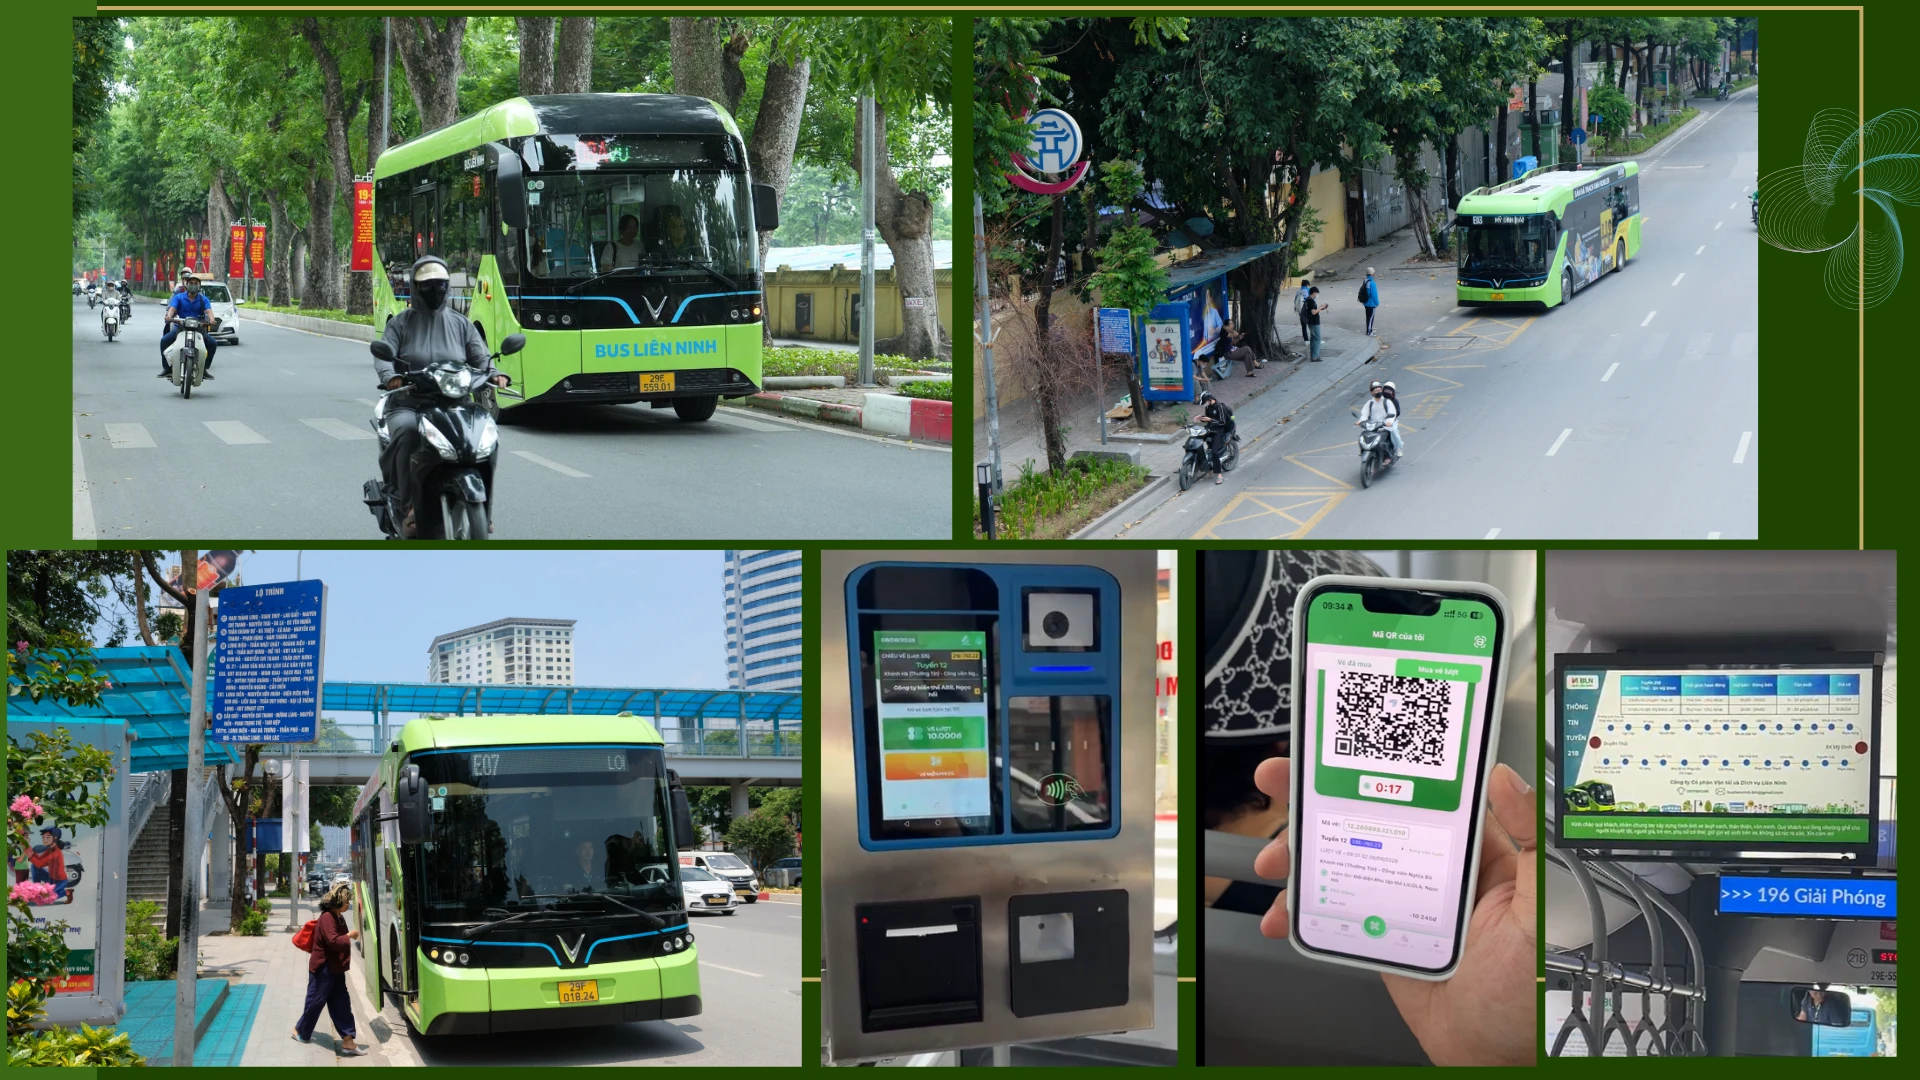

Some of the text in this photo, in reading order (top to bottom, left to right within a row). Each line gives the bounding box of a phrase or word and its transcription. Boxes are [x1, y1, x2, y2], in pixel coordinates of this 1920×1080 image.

[358, 189, 373, 200] 19-
[595, 339, 717, 358] BUS LIÊN NINH
[643, 383, 671, 391] 559.01
[255, 587, 284, 598] LỘ TRÌNH
[1323, 602, 1345, 610] 09:34
[1386, 632, 1397, 640] QR
[1399, 632, 1413, 640] của
[1414, 632, 1425, 641] tôi
[916, 661, 938, 669] Tuyến
[1418, 665, 1433, 673] Mua
[473, 754, 500, 776] E07
[1375, 782, 1402, 795] 0:17
[1321, 835, 1339, 843] Tuyến
[1381, 867, 1395, 875] Công
[1758, 887, 1886, 909] 196 Giải Phóng
[69, 926, 81, 935] mẹ
[1849, 953, 1866, 963] 21B
[570, 982, 586, 991] 29F
[564, 991, 594, 1001] 018.24
